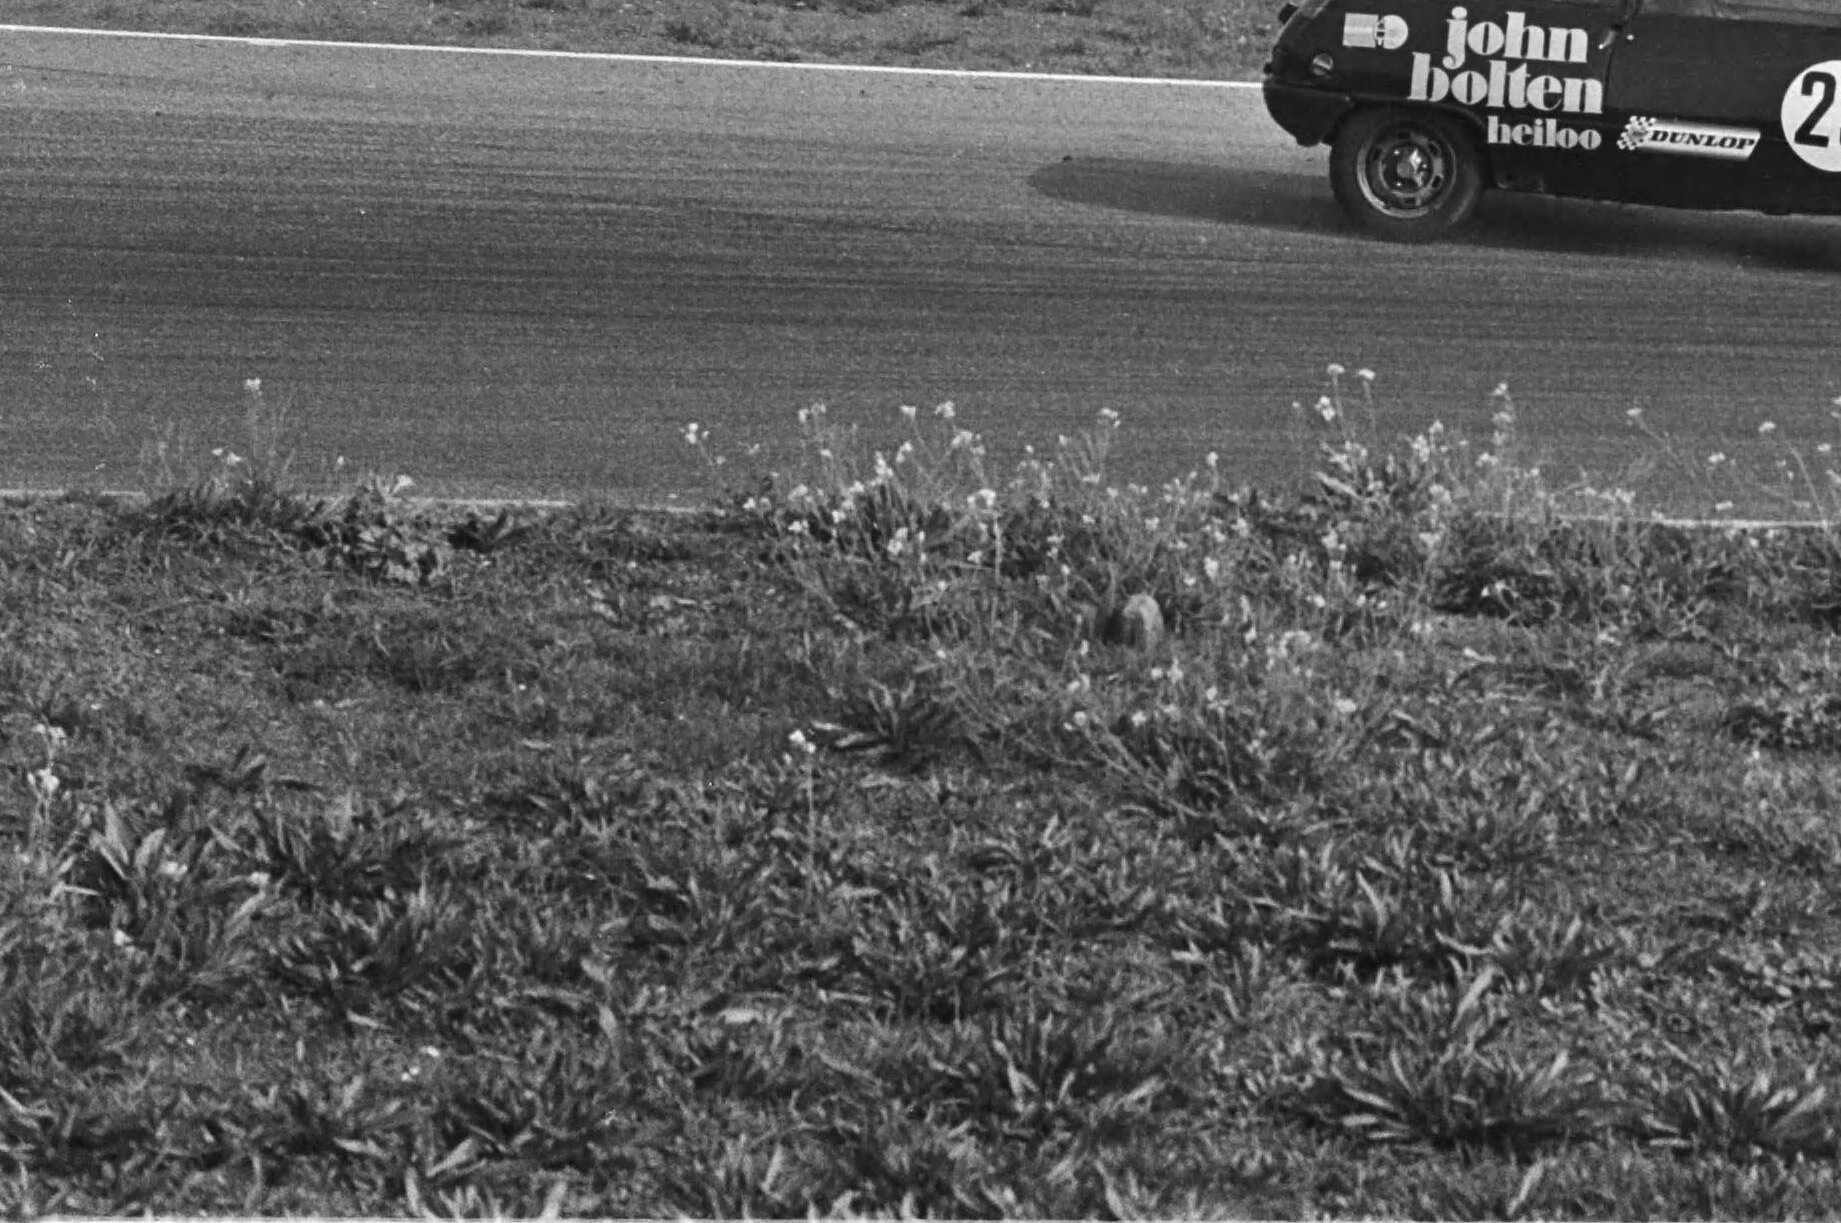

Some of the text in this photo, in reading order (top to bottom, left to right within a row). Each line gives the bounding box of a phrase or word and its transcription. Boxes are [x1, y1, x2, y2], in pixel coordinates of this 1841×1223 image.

[1442, 6, 1589, 70] john
[1407, 51, 1603, 114] bolten
[1486, 115, 1602, 151] heiloo
[1650, 130, 1756, 151] DUNLOP
